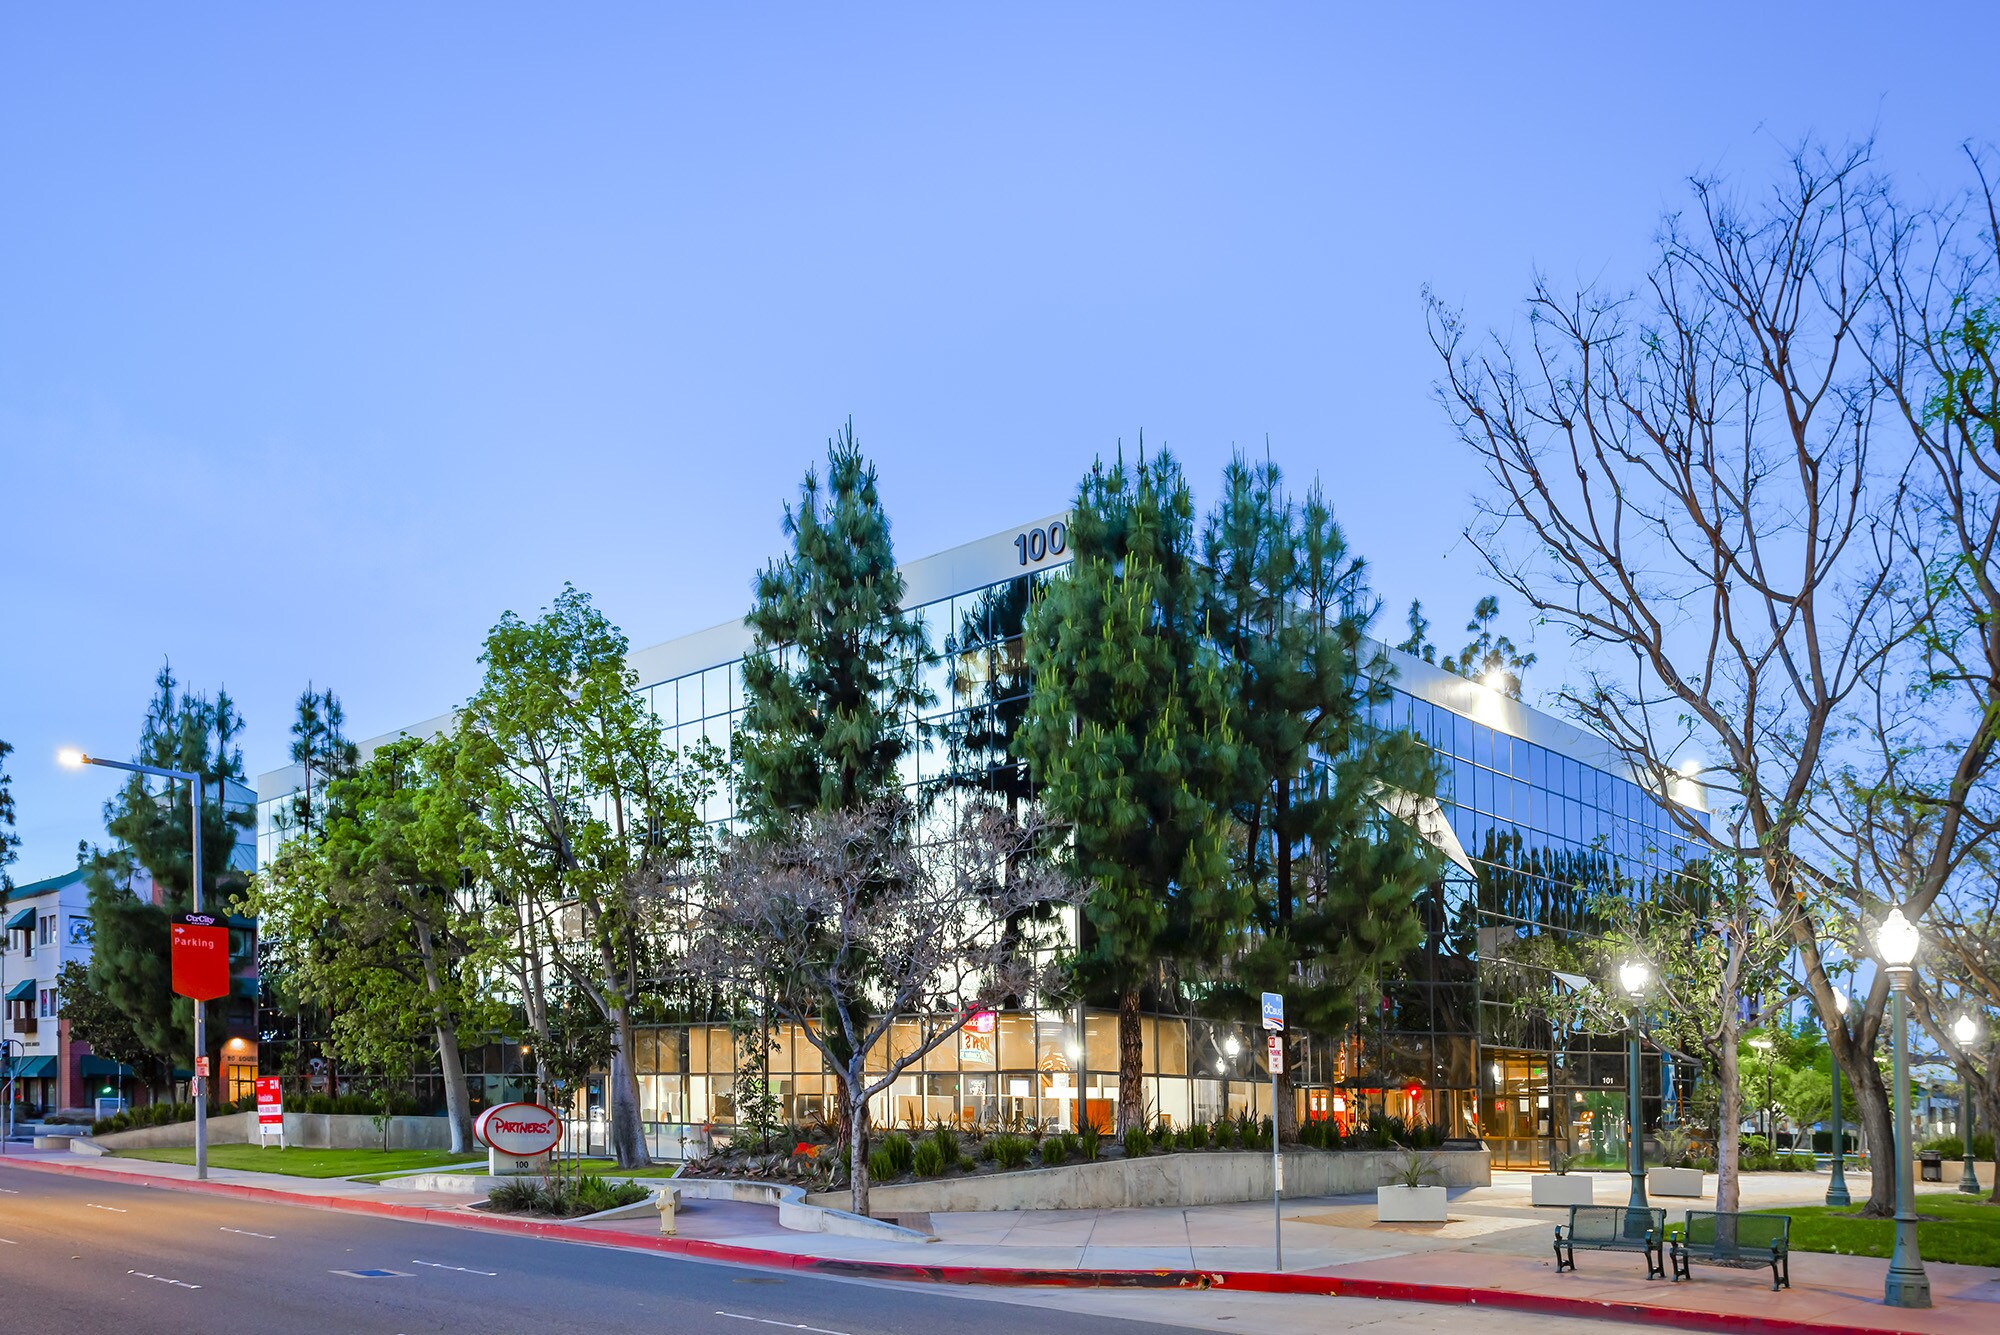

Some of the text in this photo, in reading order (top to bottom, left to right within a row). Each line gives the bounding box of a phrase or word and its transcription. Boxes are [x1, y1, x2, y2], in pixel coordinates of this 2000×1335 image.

[1014, 521, 1067, 566] 100
[174, 937, 214, 950] Parking
[1602, 1077, 1614, 1085] 101
[515, 1161, 529, 1169] 100
